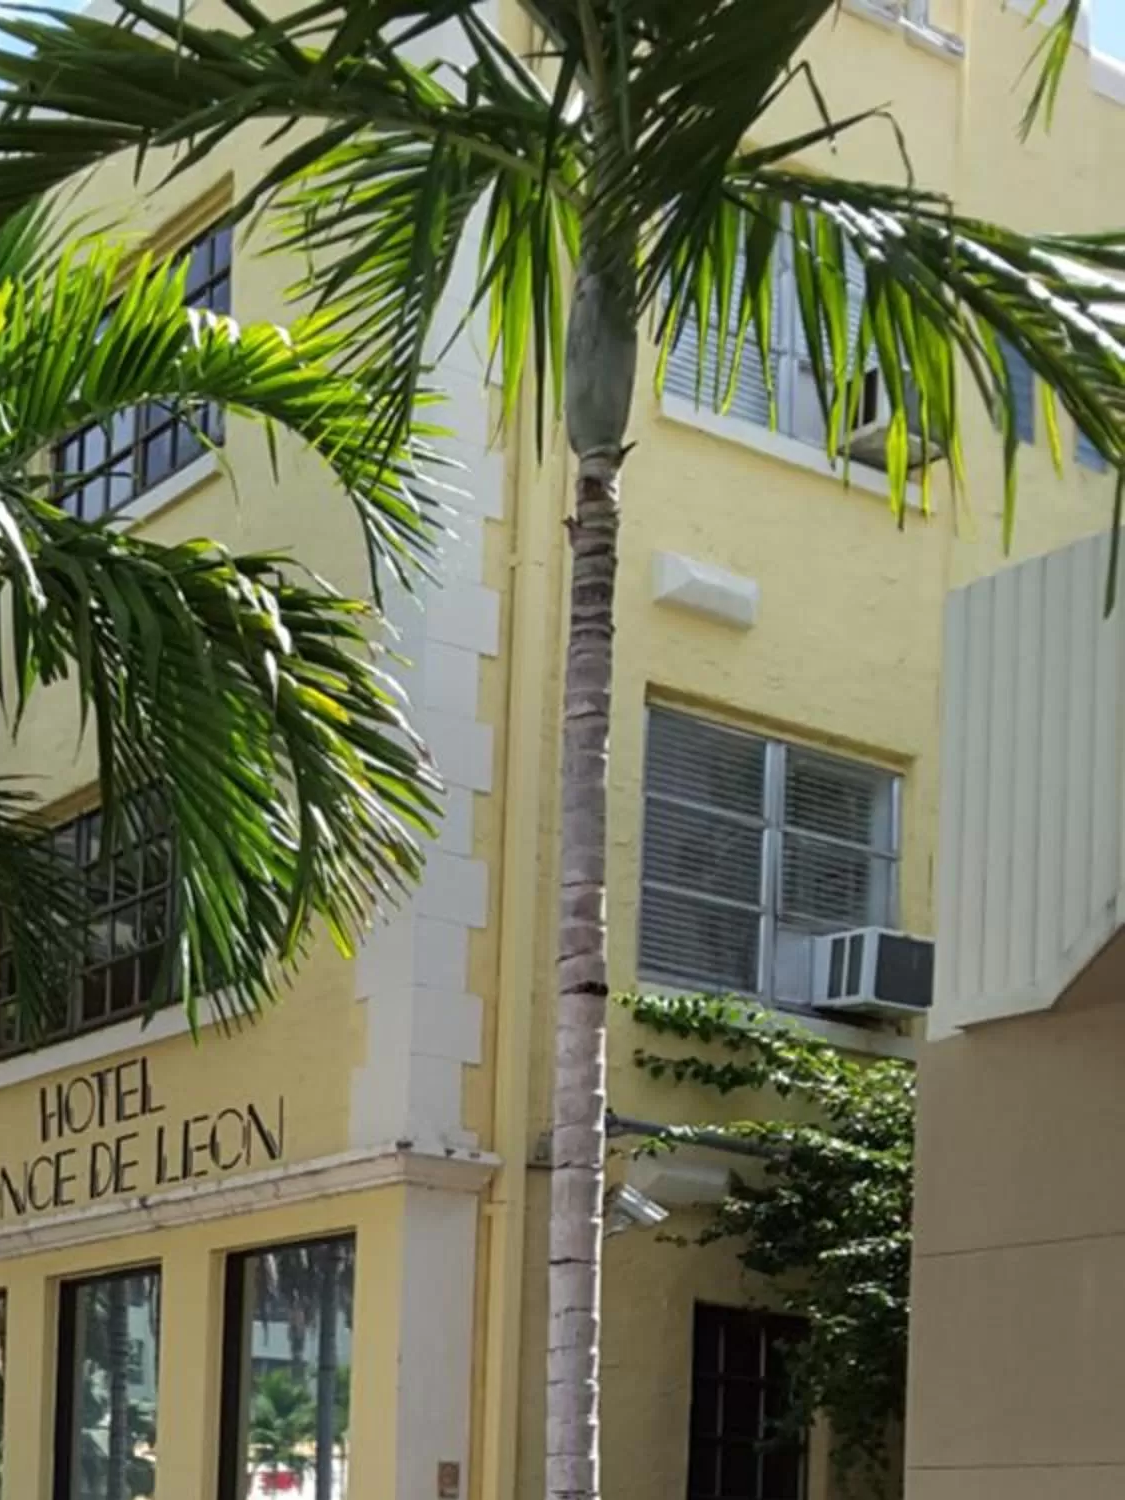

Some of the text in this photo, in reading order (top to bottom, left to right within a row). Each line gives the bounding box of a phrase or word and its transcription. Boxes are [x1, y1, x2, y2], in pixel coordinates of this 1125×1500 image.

[40, 1056, 166, 1142] HOTEL
[89, 1132, 140, 1199] DE
[155, 1095, 284, 1186] LEON
